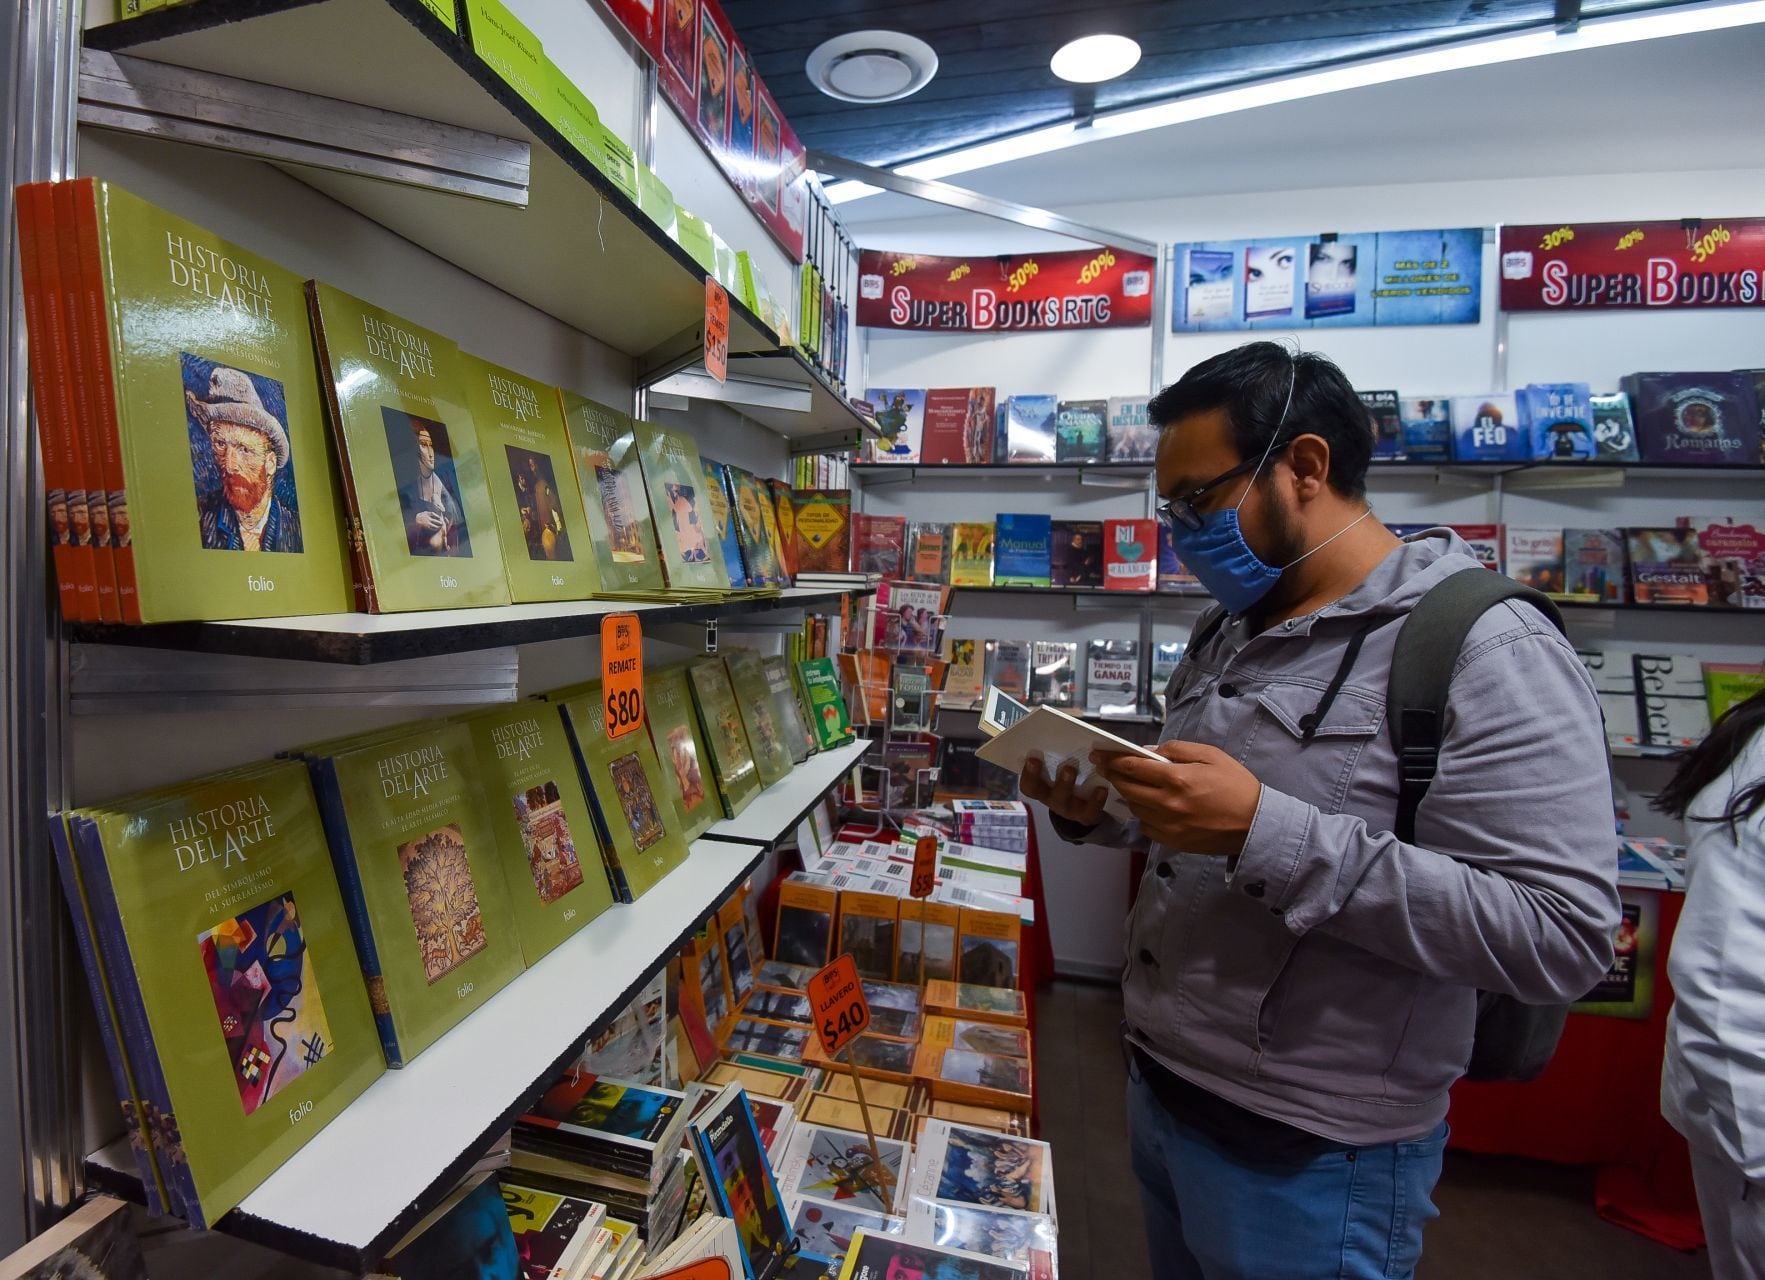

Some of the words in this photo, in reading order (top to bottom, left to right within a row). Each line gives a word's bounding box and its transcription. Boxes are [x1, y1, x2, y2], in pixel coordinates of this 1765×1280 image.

[1539, 226, 1575, 250] -30%
[1690, 224, 1730, 263] -50%
[166, 231, 272, 298] HISTORIA
[889, 259, 917, 276] -30%
[947, 263, 971, 282] -40%
[1006, 259, 1039, 293] -50%
[1076, 250, 1116, 285] -60%
[1063, 294, 1111, 323] RTC
[362, 315, 433, 358] HISTORIA
[706, 327, 727, 366] $150
[488, 373, 538, 403] HISTORIA
[582, 405, 617, 428] HISTORIA
[1481, 416, 1495, 428] EL
[1473, 426, 1507, 448] FEO
[1000, 538, 1047, 549] Manual
[247, 575, 275, 592] folio
[440, 575, 458, 589] folio
[551, 575, 564, 587] folio
[1638, 572, 1701, 584] Gestalt
[608, 658, 637, 676] REMATE
[1093, 661, 1121, 670] TIEMPO
[1123, 662, 1132, 670] DE
[1094, 670, 1132, 681] GANAR
[607, 687, 641, 736] $80
[491, 718, 541, 744] HISTORIA
[377, 744, 444, 778] HISTORIA
[168, 794, 271, 845] HISTORIA
[204, 886, 221, 902] DEL
[222, 866, 273, 896] SIMBOLISMO
[563, 907, 577, 921] folio
[456, 981, 475, 1000] folio
[820, 981, 856, 1013] LLAVERO
[822, 1001, 865, 1051] $40
[288, 1099, 314, 1125] folio
